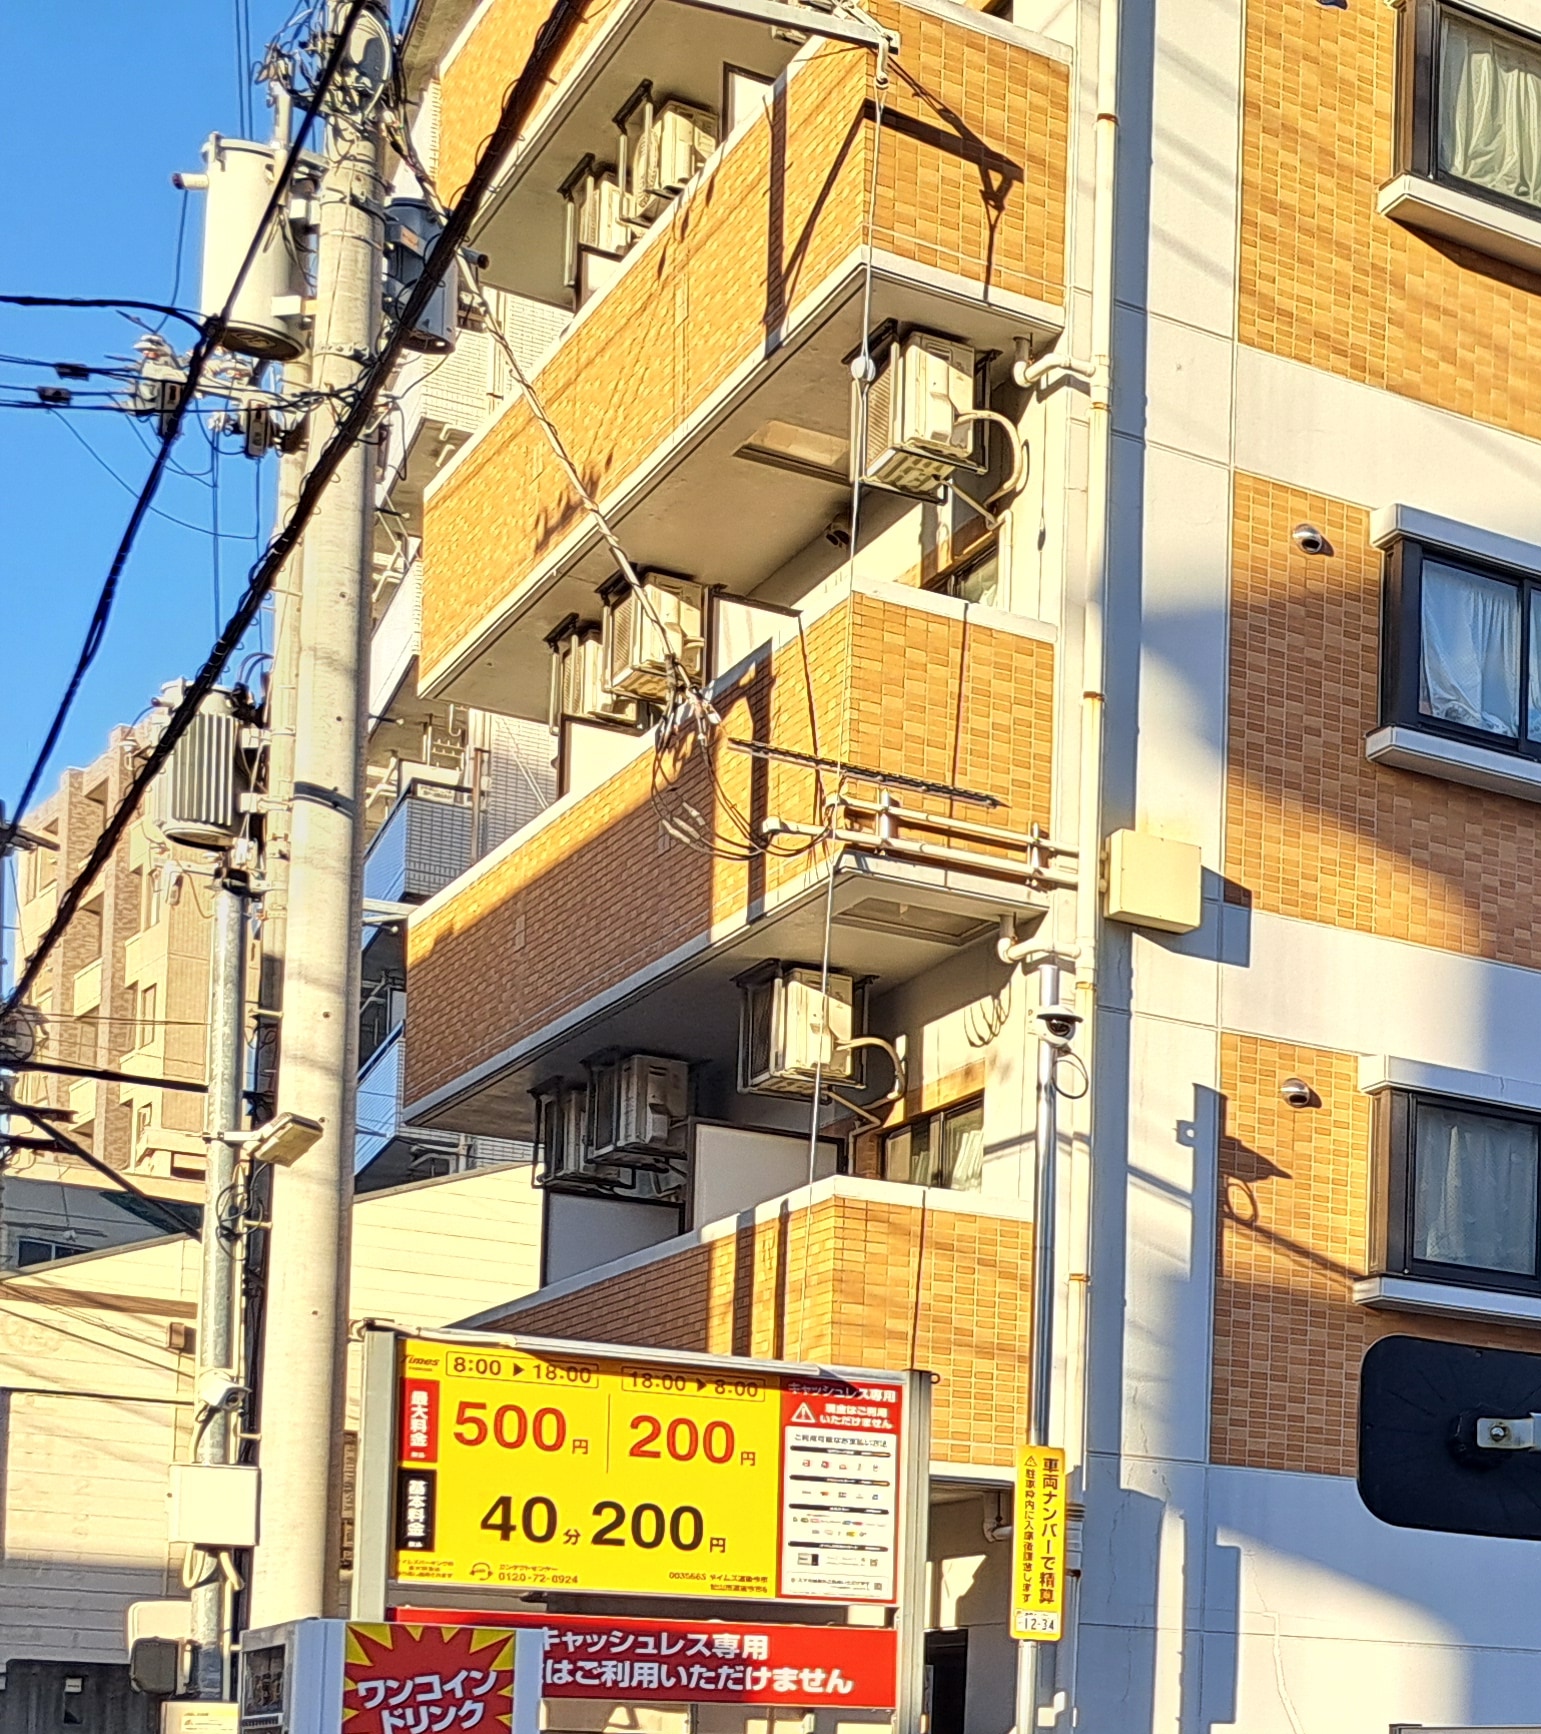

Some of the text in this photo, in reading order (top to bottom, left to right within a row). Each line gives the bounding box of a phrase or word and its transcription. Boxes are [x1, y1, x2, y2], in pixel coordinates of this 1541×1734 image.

[453, 1356, 593, 1384] 8:00 18:00
[630, 1371, 759, 1398] 18:00 8:00
[1039, 1457, 1059, 1605] 車両ナンバーで精算
[356, 1668, 499, 1708] ワンコイン
[541, 1659, 854, 1695] はご利用いただけません
